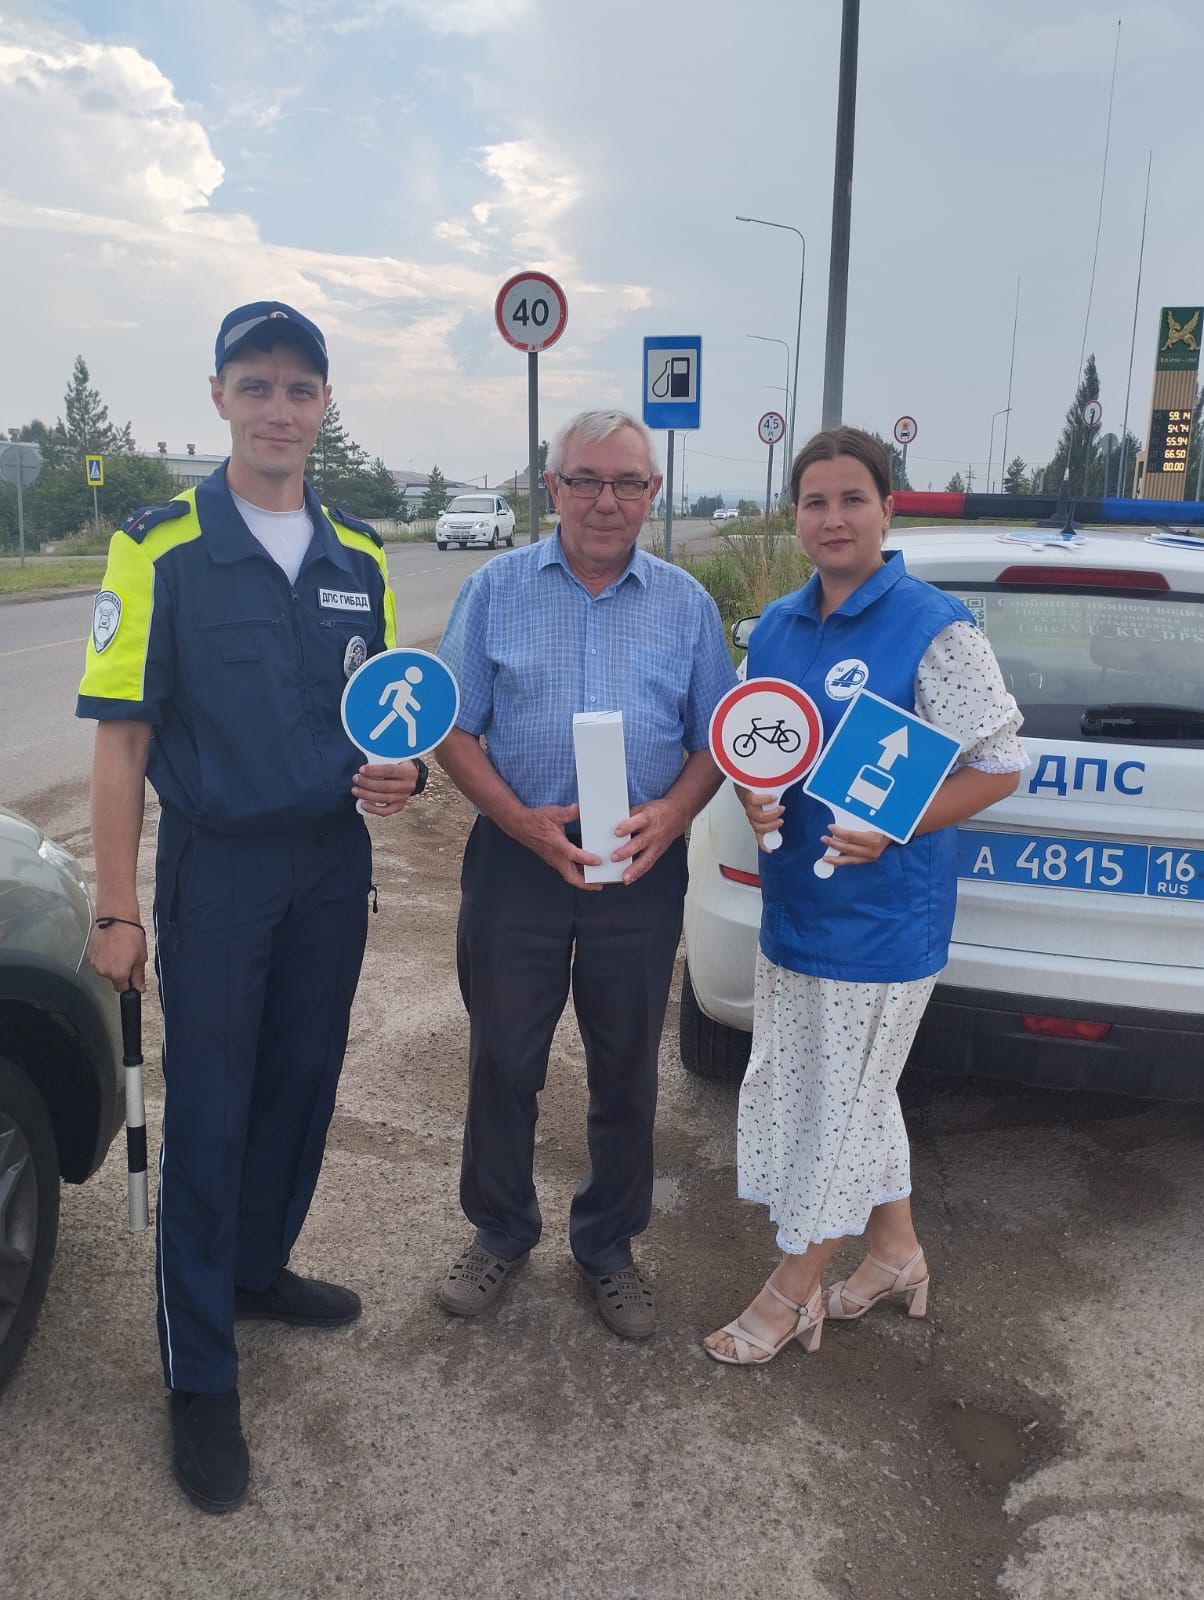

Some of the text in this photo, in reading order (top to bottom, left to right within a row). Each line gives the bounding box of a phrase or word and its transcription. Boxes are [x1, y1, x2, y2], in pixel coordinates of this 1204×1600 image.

[512, 298, 550, 327] 40
[322, 592, 369, 608] ДПС ГИБДД
[1028, 754, 1146, 796] ДПС
[972, 841, 1124, 887] А 4815
[1155, 851, 1196, 882] 16
[1157, 882, 1189, 896] RUS
